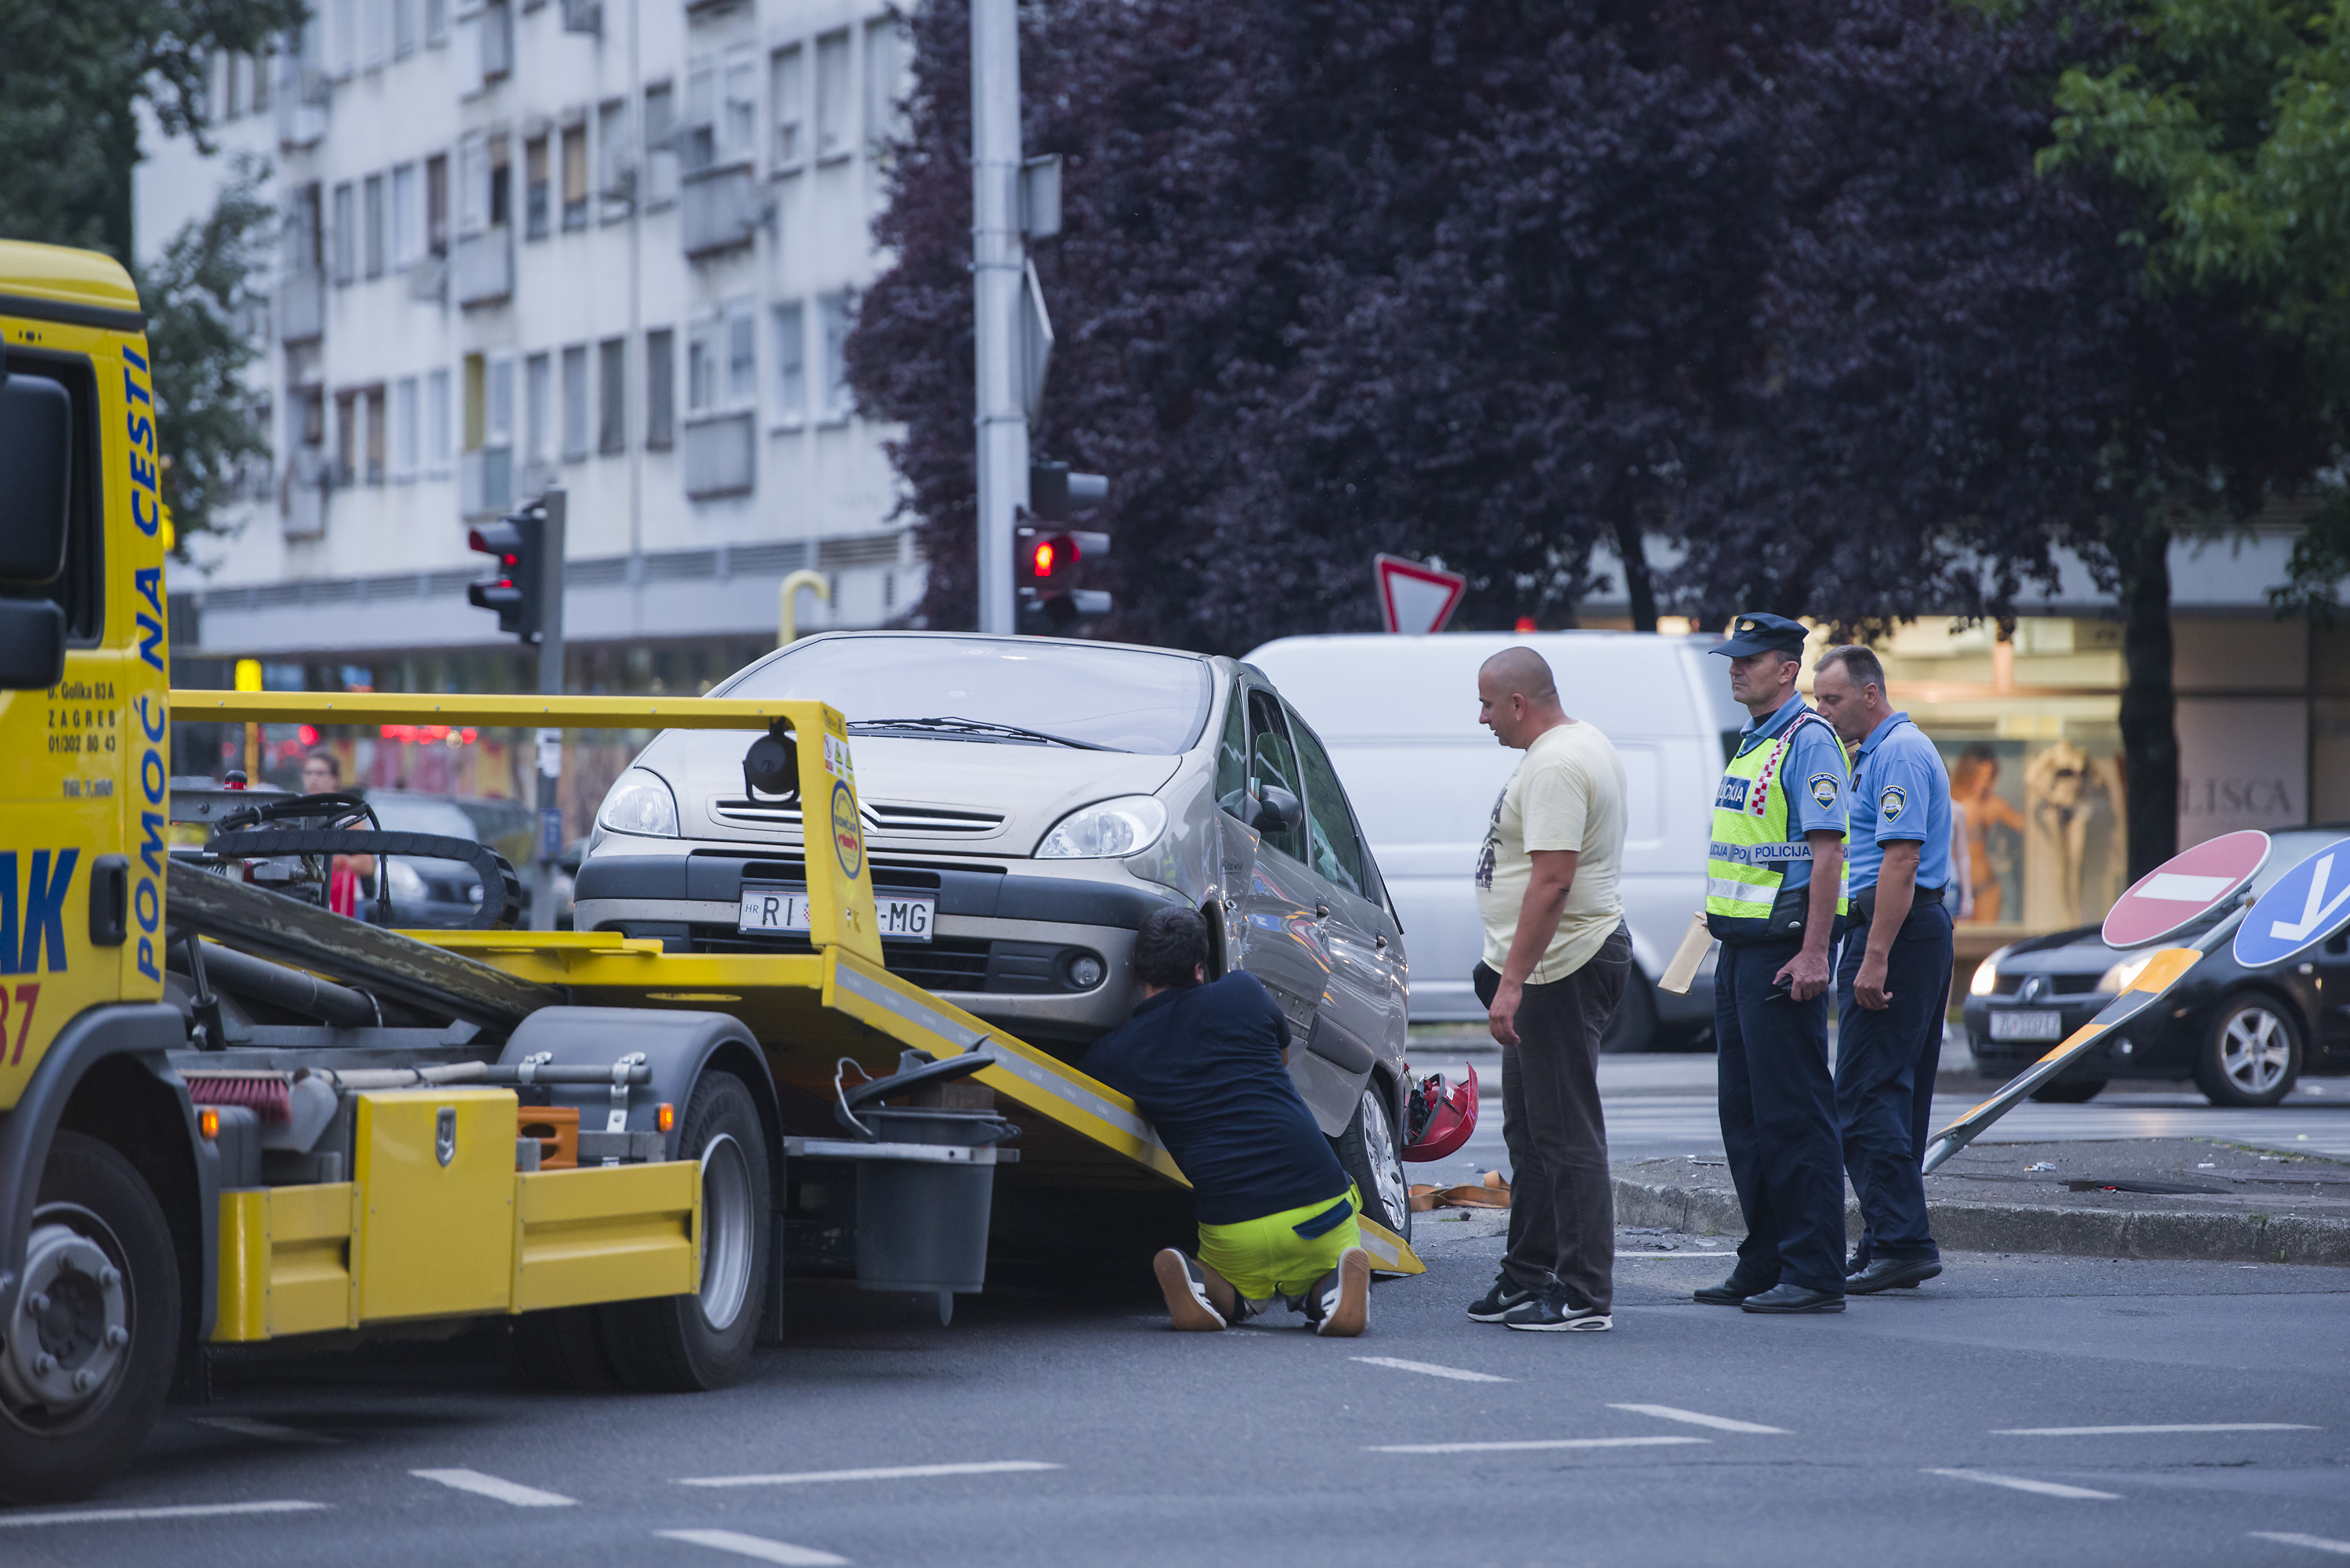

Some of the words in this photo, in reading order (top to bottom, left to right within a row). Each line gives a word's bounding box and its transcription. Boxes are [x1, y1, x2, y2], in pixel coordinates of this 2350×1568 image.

[122, 344, 159, 537] CESTI
[136, 566, 164, 673] NA
[49, 734, 81, 752] 01/302
[87, 734, 99, 752] 80
[105, 734, 115, 752] 43
[1810, 775, 1838, 784] POLICIJA
[1881, 787, 1904, 797] POLICIJA
[134, 695, 165, 983] POMOĆ
[1755, 846, 1811, 858] POLICIJA
[745, 904, 759, 914] HR
[763, 897, 793, 926] RI
